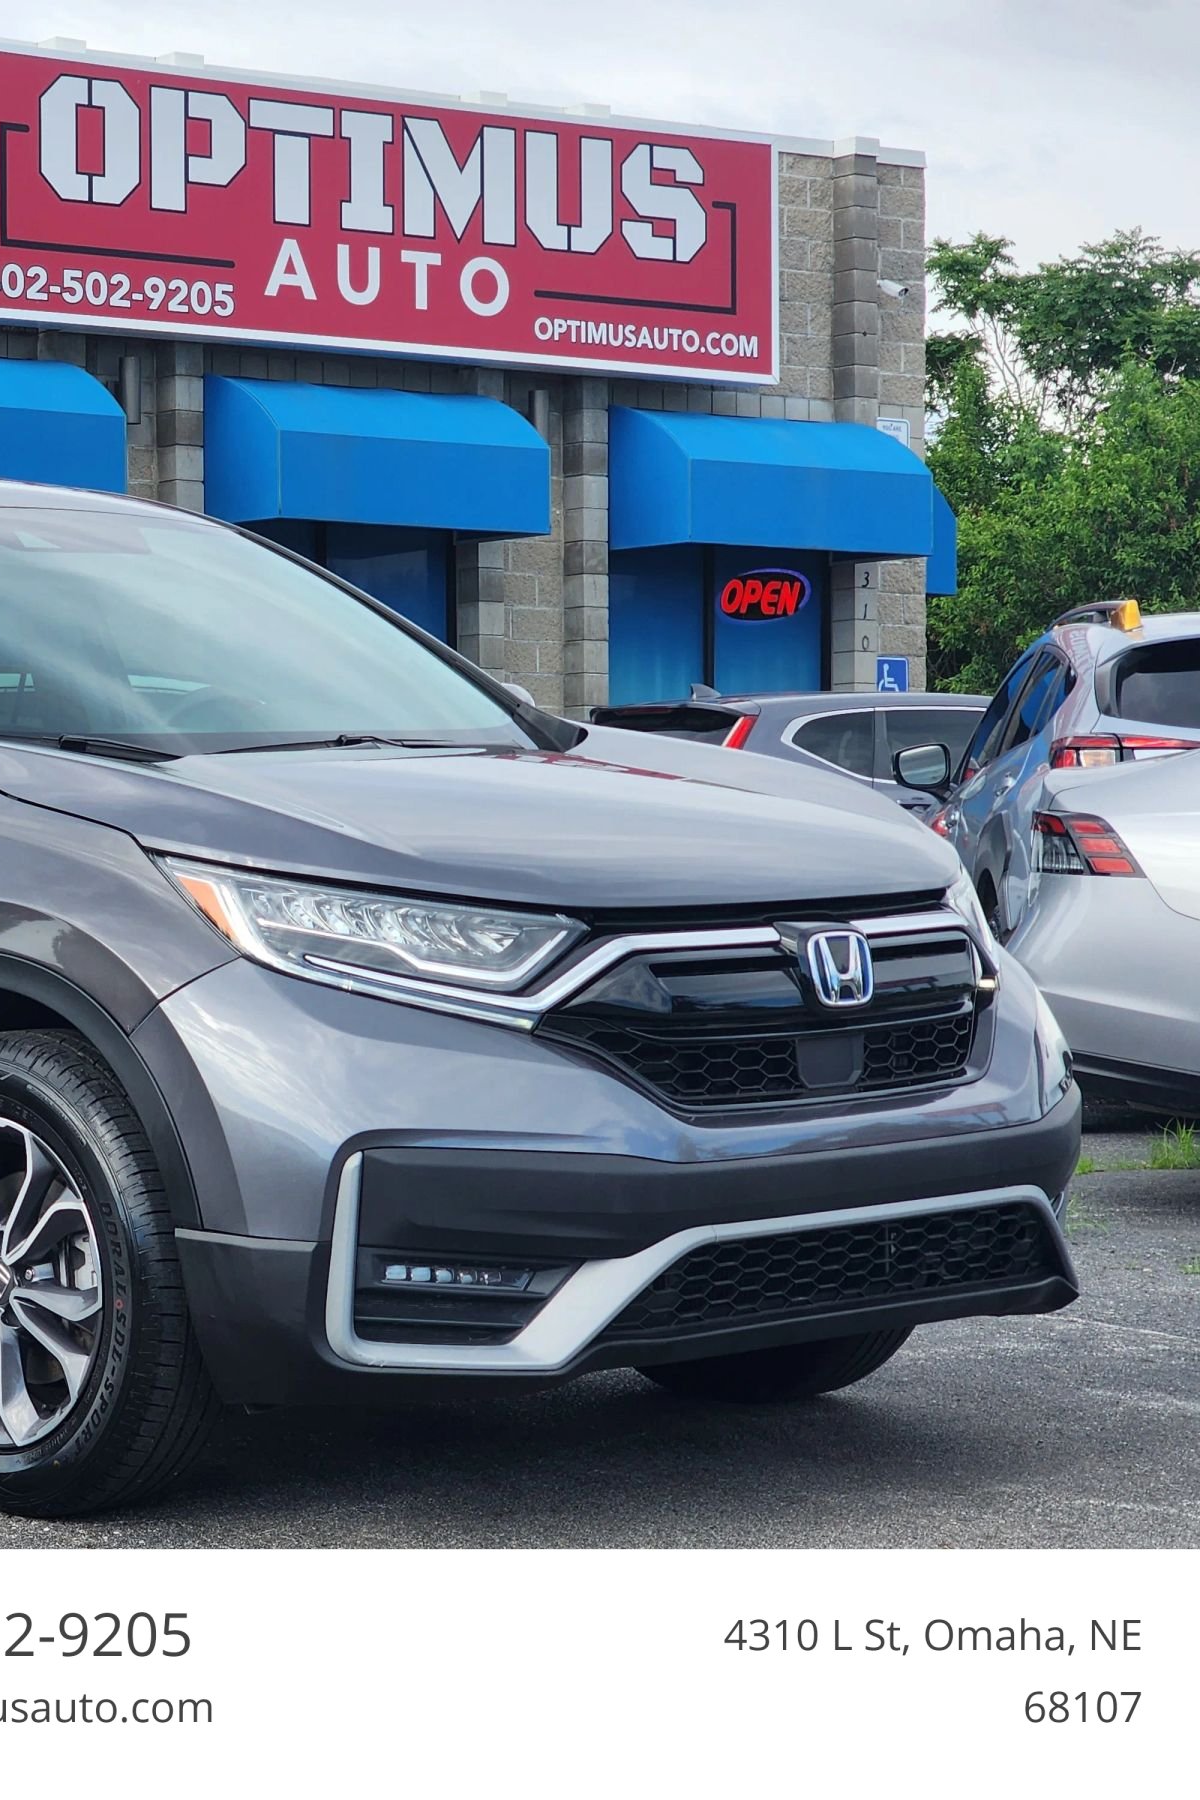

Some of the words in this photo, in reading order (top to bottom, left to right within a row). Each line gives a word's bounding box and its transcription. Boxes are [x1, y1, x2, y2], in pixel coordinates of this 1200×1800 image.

[39, 74, 707, 263] OPTIMUS
[264, 238, 510, 316] AUTO
[534, 317, 759, 358] OPTIMUSAUTO.COM
[721, 579, 801, 616] OPEN
